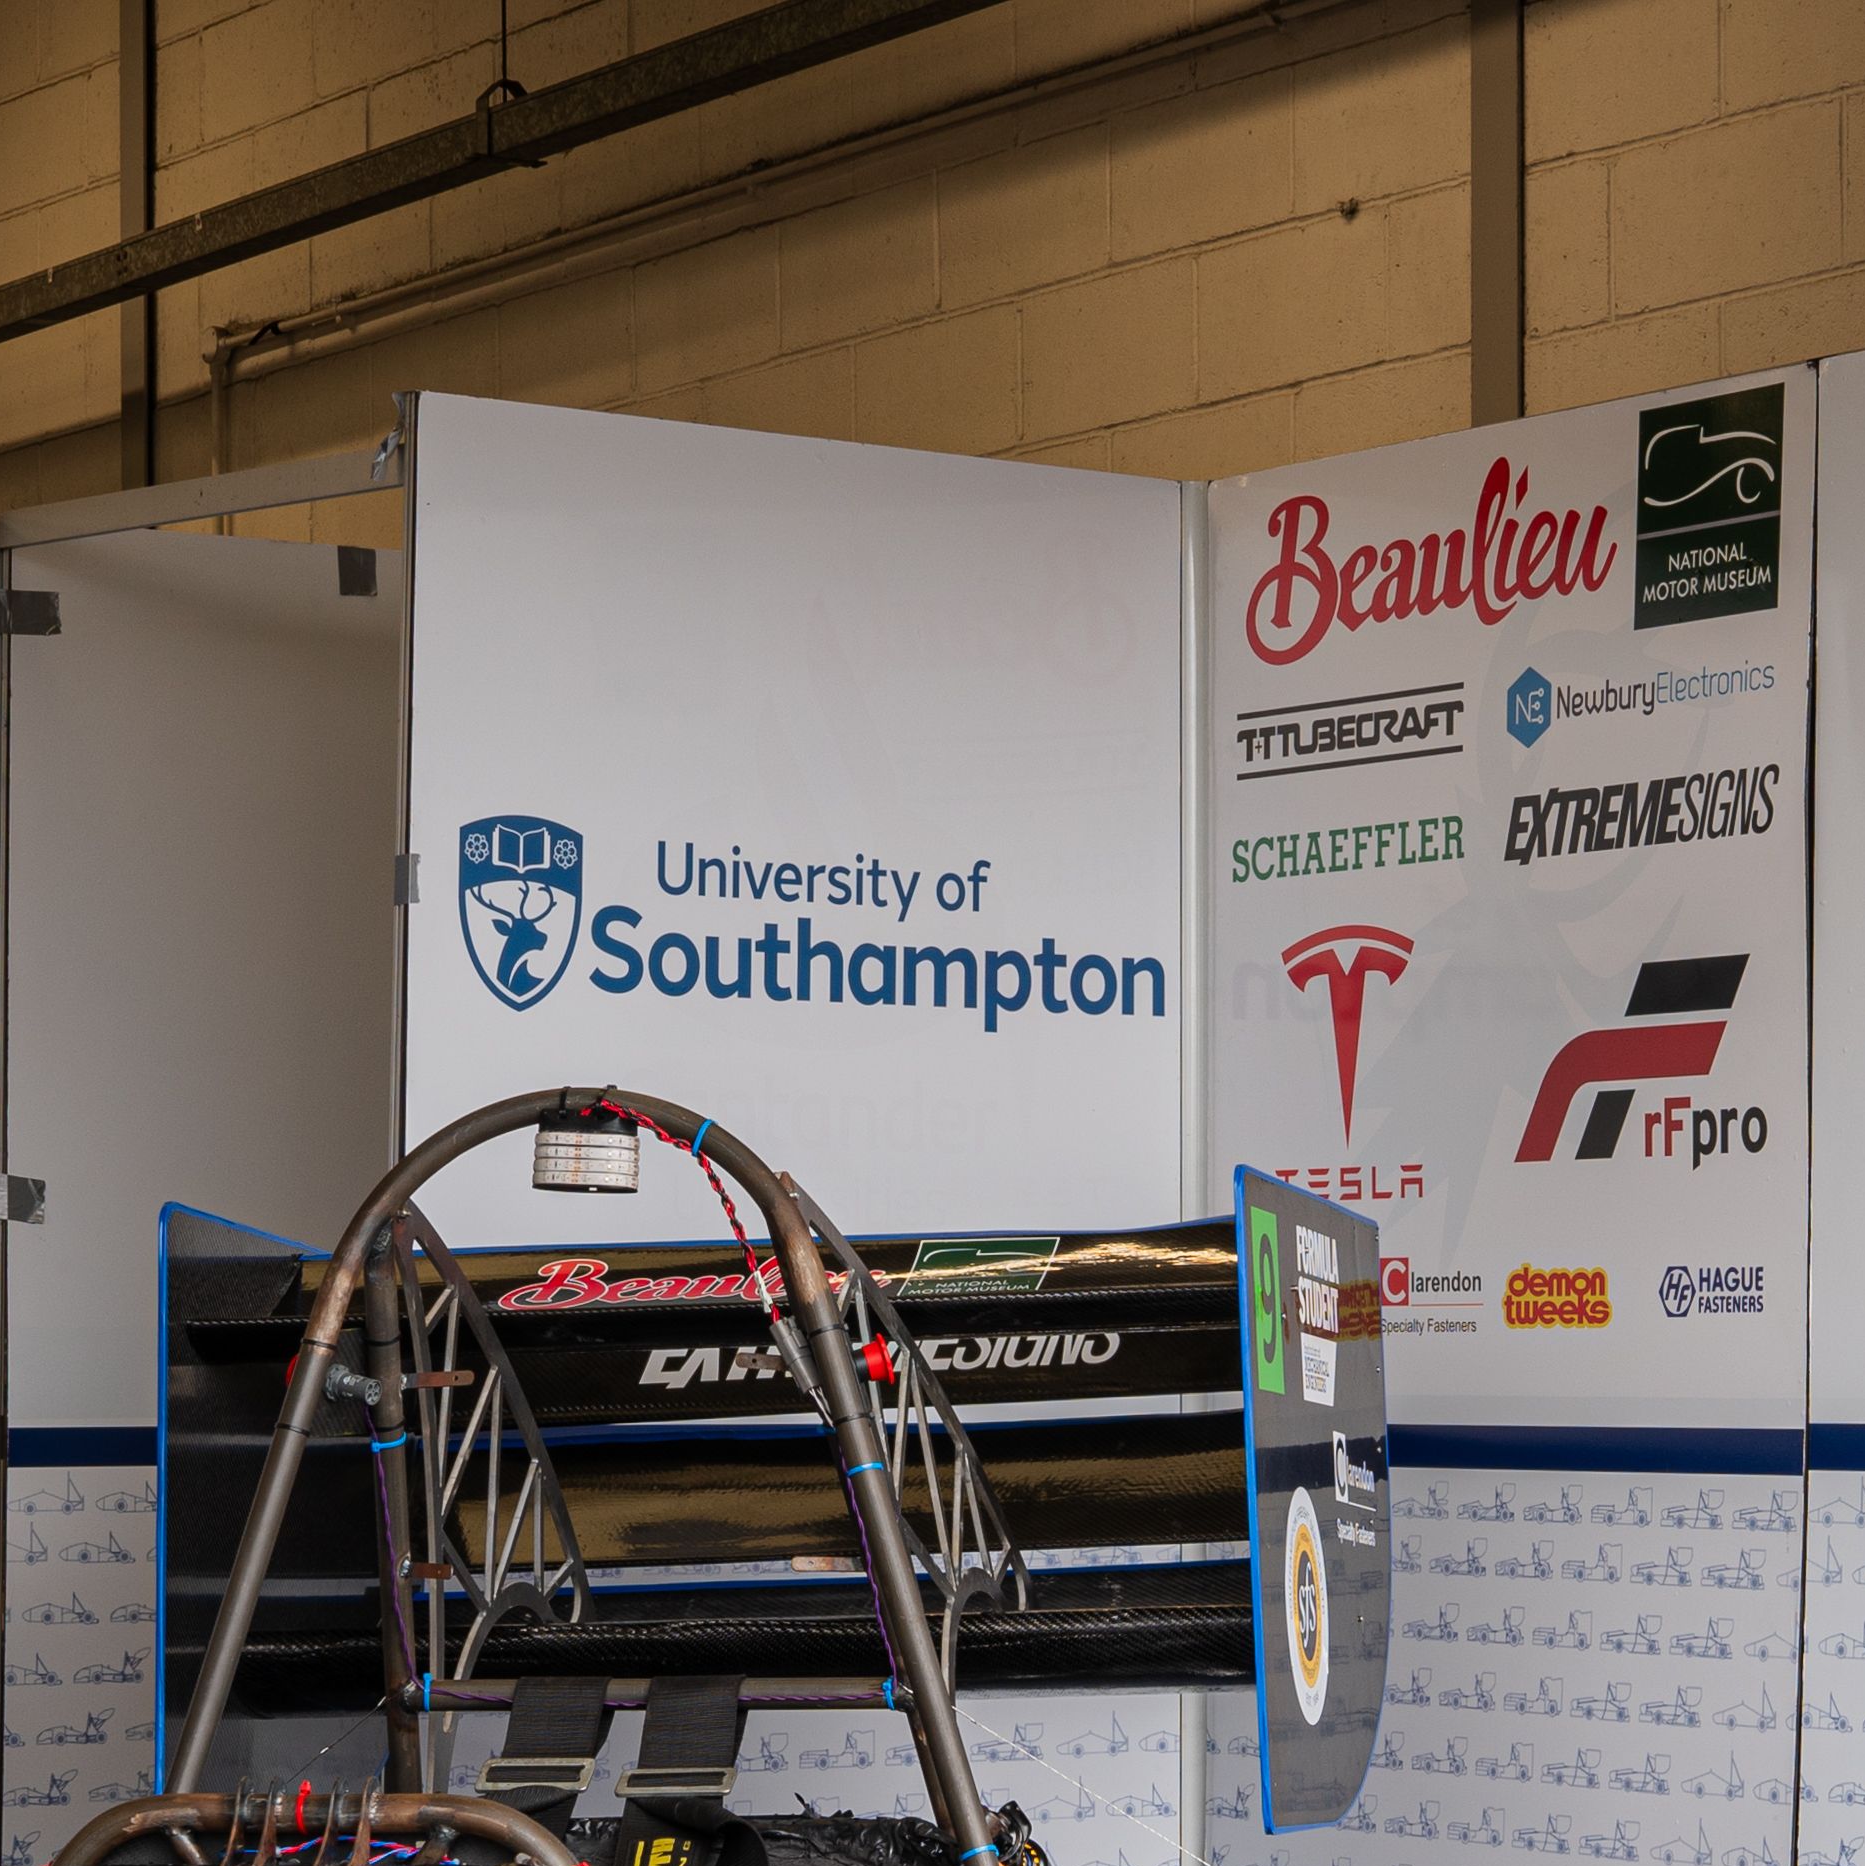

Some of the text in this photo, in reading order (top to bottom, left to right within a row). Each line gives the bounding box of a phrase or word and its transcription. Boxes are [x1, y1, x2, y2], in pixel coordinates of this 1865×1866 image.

[1246, 456, 1617, 665] Beaulieu
[1668, 542, 1747, 572] NATIONAL
[1642, 567, 1771, 604] MOTOR MUSEUM
[1232, 815, 1465, 883] SCHAEFFLER
[658, 841, 991, 922] University of
[589, 905, 1166, 1032] Southampton
[1645, 1096, 1767, 1170] rFpro
[1296, 1224, 1339, 1284] FORMULA
[908, 1284, 1030, 1295] MOTOR MUSEUM
[936, 1280, 1008, 1289] NATIONAL
[1259, 1233, 1276, 1364] 9
[1382, 1260, 1481, 1303] Clarendon
[1509, 1267, 1606, 1296] demon
[1699, 1267, 1764, 1292] HAGUE
[1298, 1276, 1339, 1333] STUDENT
[1505, 1296, 1610, 1324] tweeks
[1699, 1296, 1764, 1313] FASTENERS
[1427, 1318, 1477, 1332] Fasteners
